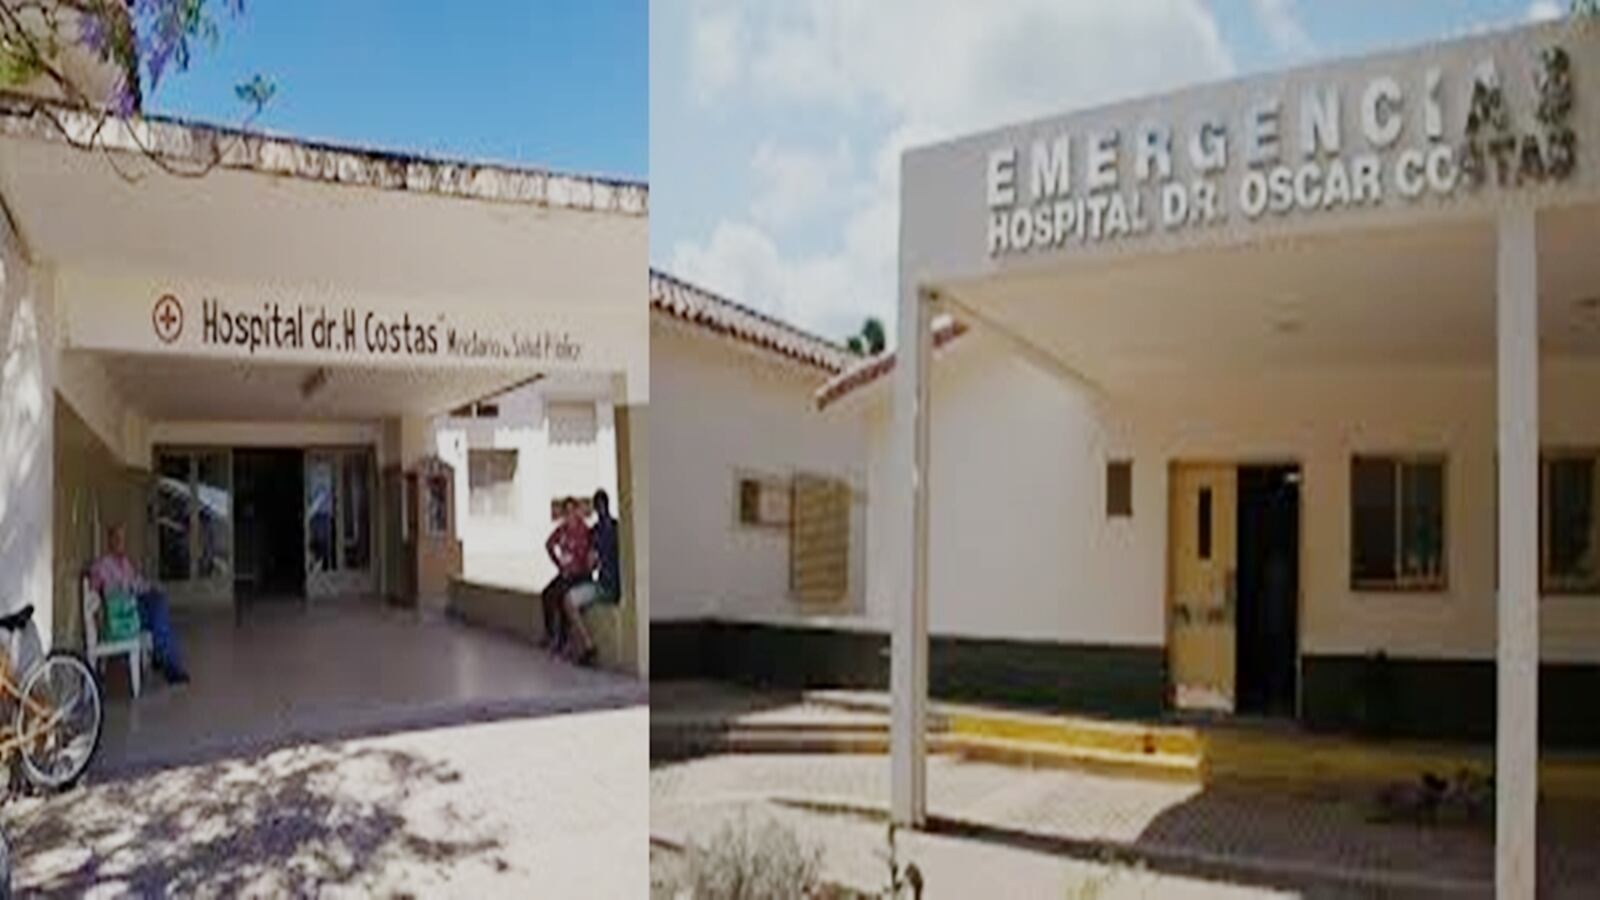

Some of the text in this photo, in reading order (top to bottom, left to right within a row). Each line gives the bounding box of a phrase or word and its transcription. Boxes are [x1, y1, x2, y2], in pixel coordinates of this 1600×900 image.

[987, 193, 1149, 255] HOSPITAL
[1240, 155, 1382, 217] OSCAR
[1395, 131, 1575, 198] COSTAS
[202, 297, 304, 354] Hospital
